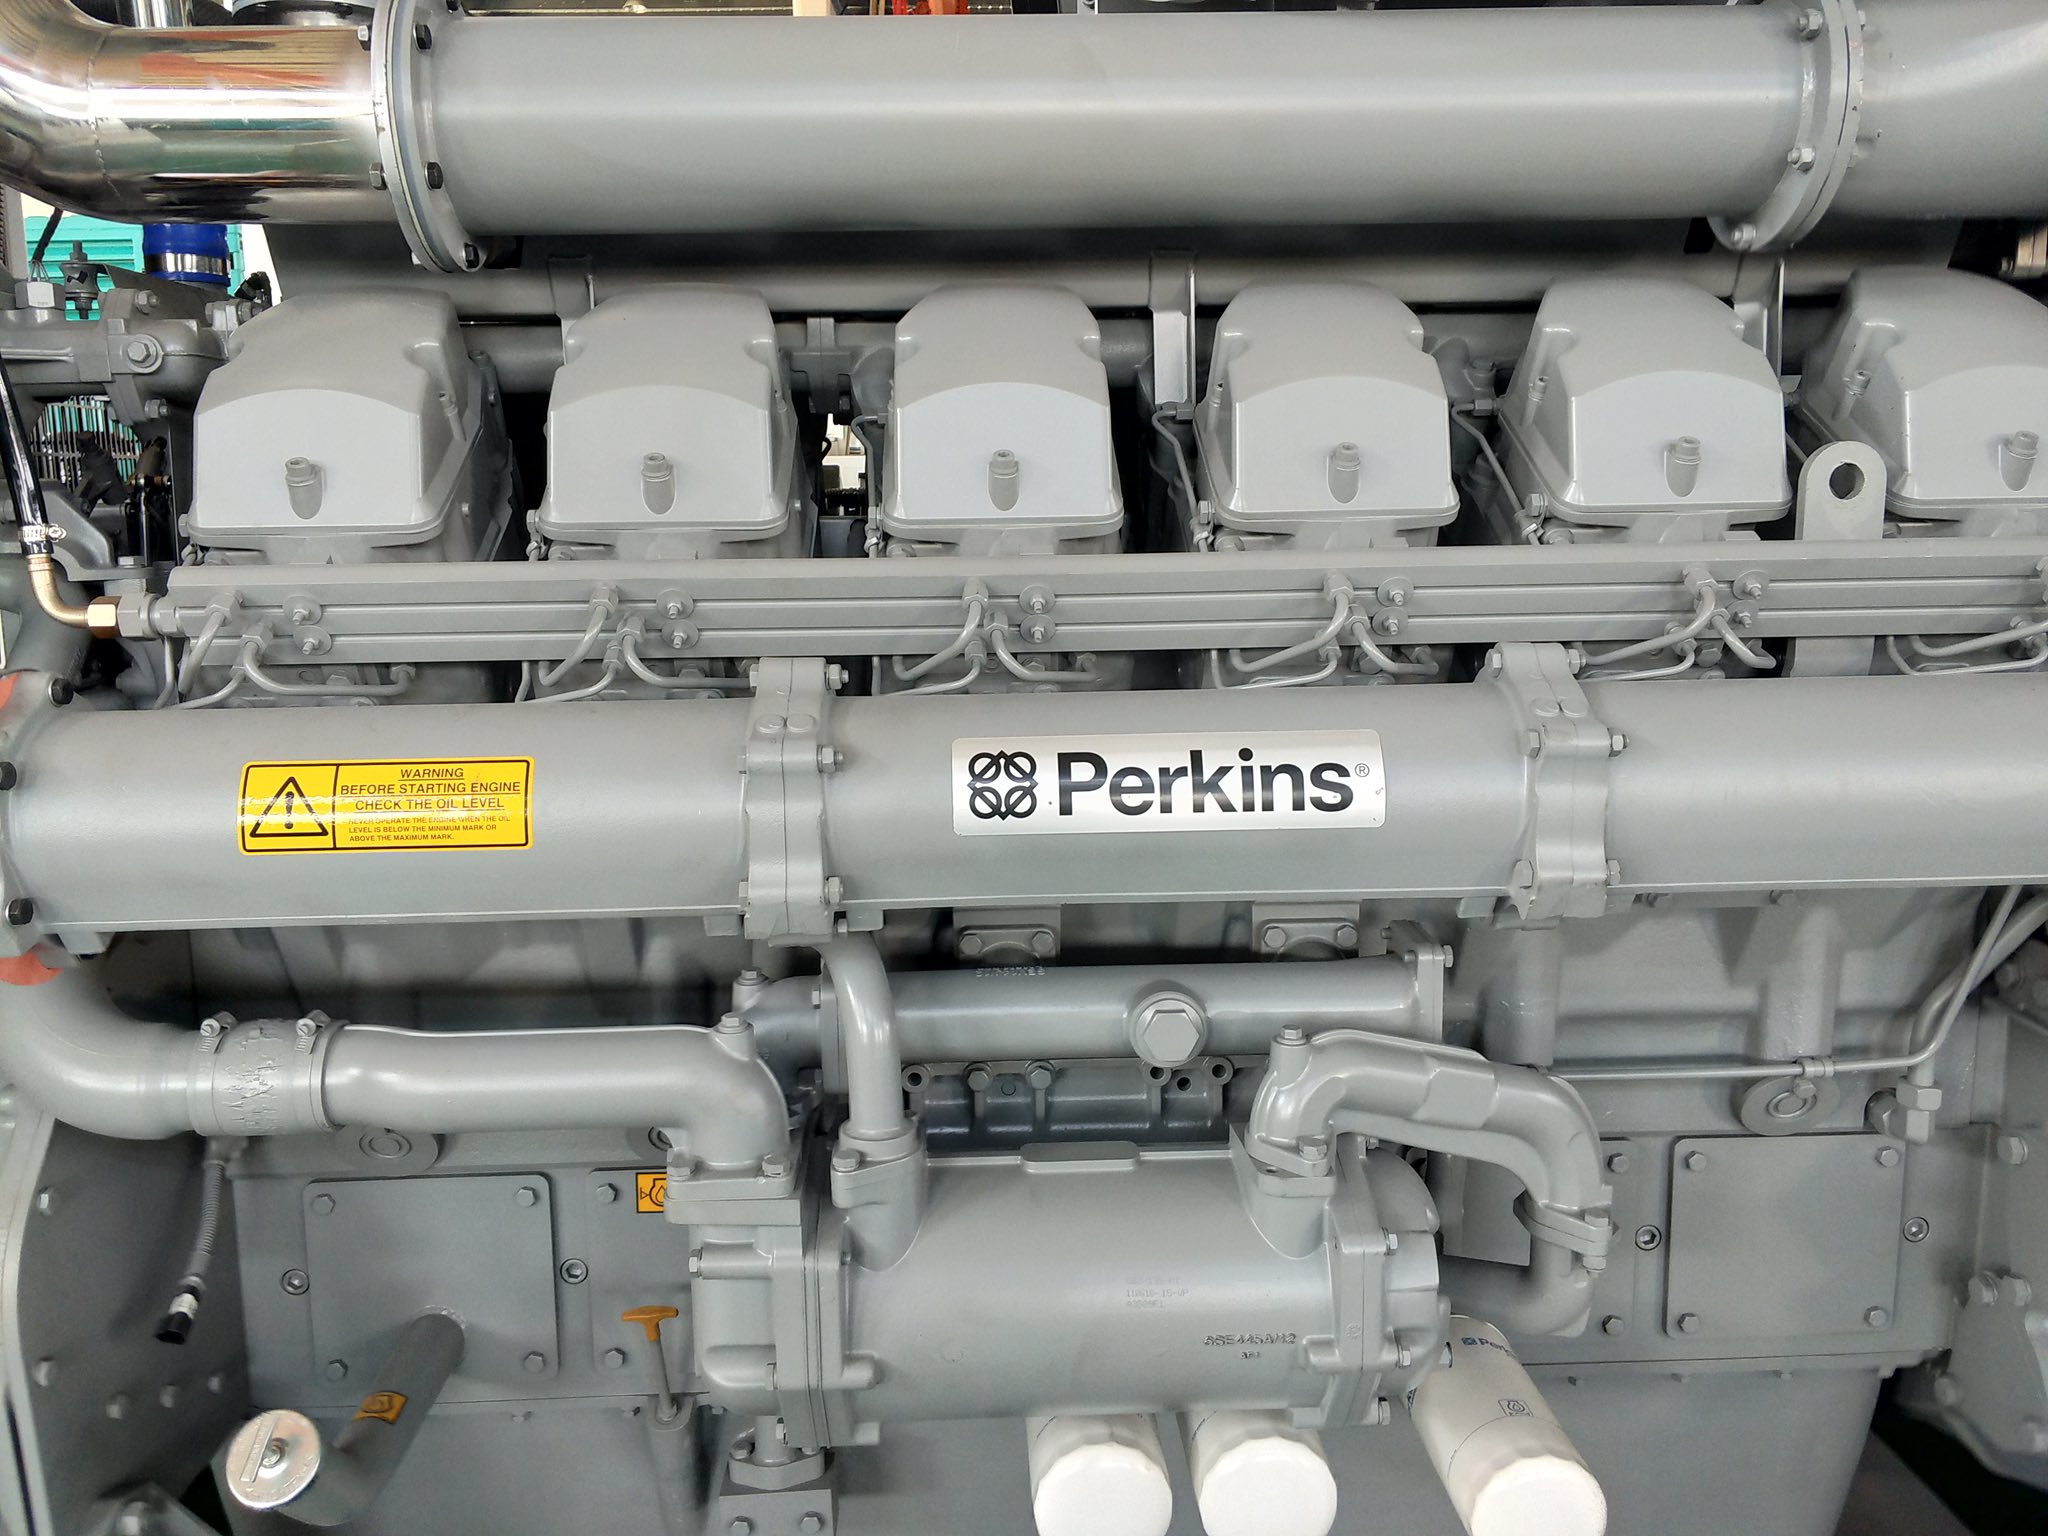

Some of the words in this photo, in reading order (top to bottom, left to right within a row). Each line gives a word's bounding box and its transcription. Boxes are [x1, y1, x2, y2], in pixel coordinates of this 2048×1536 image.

[400, 768, 464, 778] WARNING
[340, 784, 395, 795] BEFORE
[399, 782, 466, 794] STARTING
[470, 781, 521, 793] ENGINE
[355, 800, 401, 810] CHECK
[406, 799, 433, 809] THE
[436, 798, 458, 809] OIL
[462, 797, 505, 808] LEVEL
[383, 825, 410, 833] BELOW
[485, 823, 497, 831] OR
[430, 833, 454, 841] MARK.
